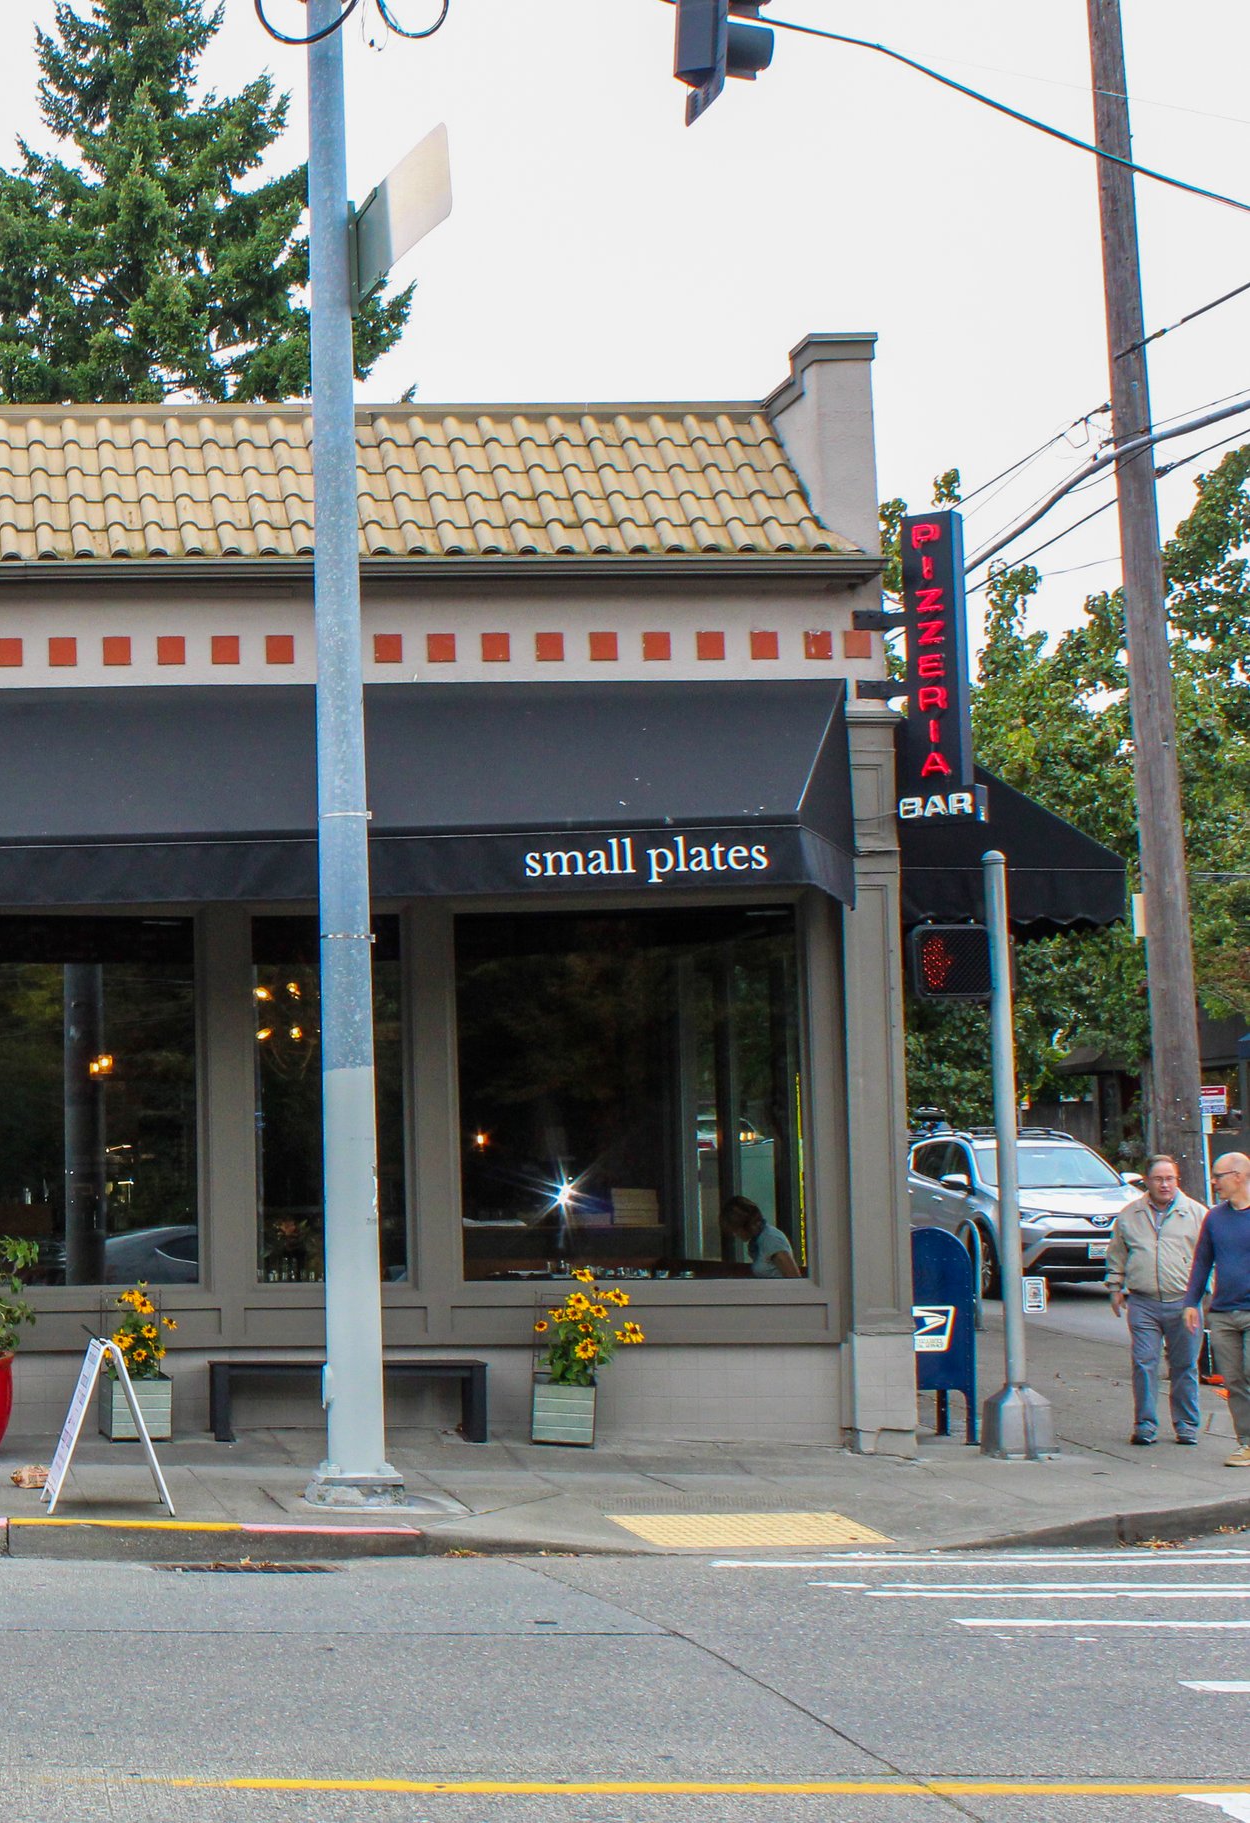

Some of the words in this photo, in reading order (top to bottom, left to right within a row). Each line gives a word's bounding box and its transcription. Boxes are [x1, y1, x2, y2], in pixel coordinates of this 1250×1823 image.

[911, 523, 951, 777] PIZZERIA
[899, 792, 974, 819] BAR
[524, 837, 637, 877] small
[646, 835, 770, 883] plates
